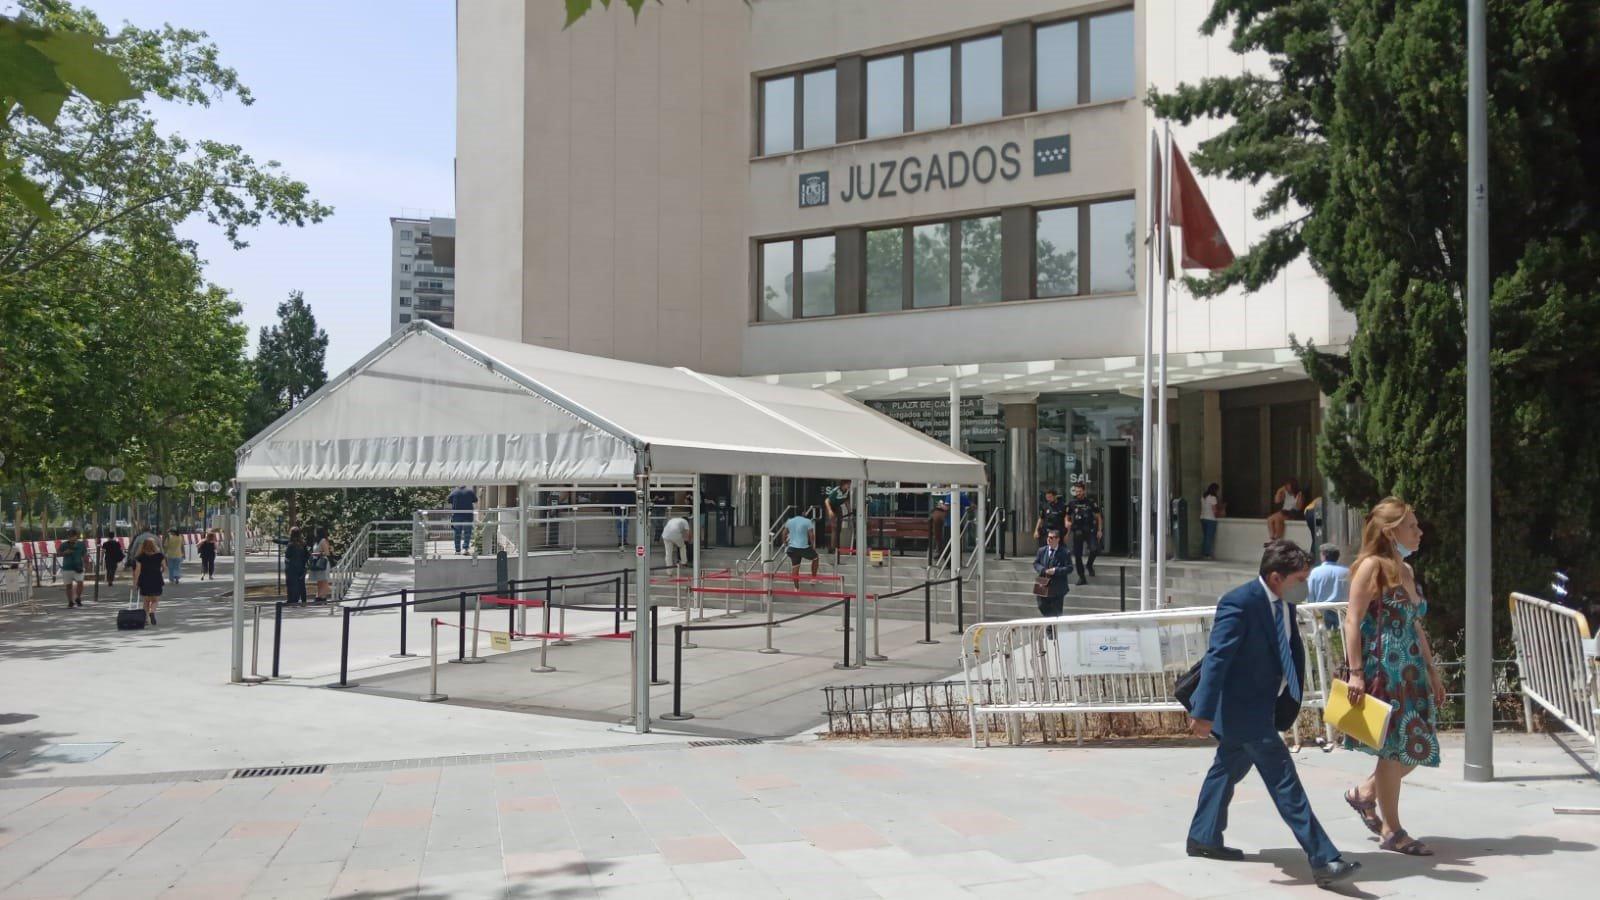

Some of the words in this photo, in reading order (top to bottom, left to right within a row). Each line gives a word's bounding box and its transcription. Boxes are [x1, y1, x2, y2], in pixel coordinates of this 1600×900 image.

[841, 142, 1022, 202] JUZGADOS
[892, 401, 918, 409] PLAZA
[972, 426, 998, 434] Madrid
